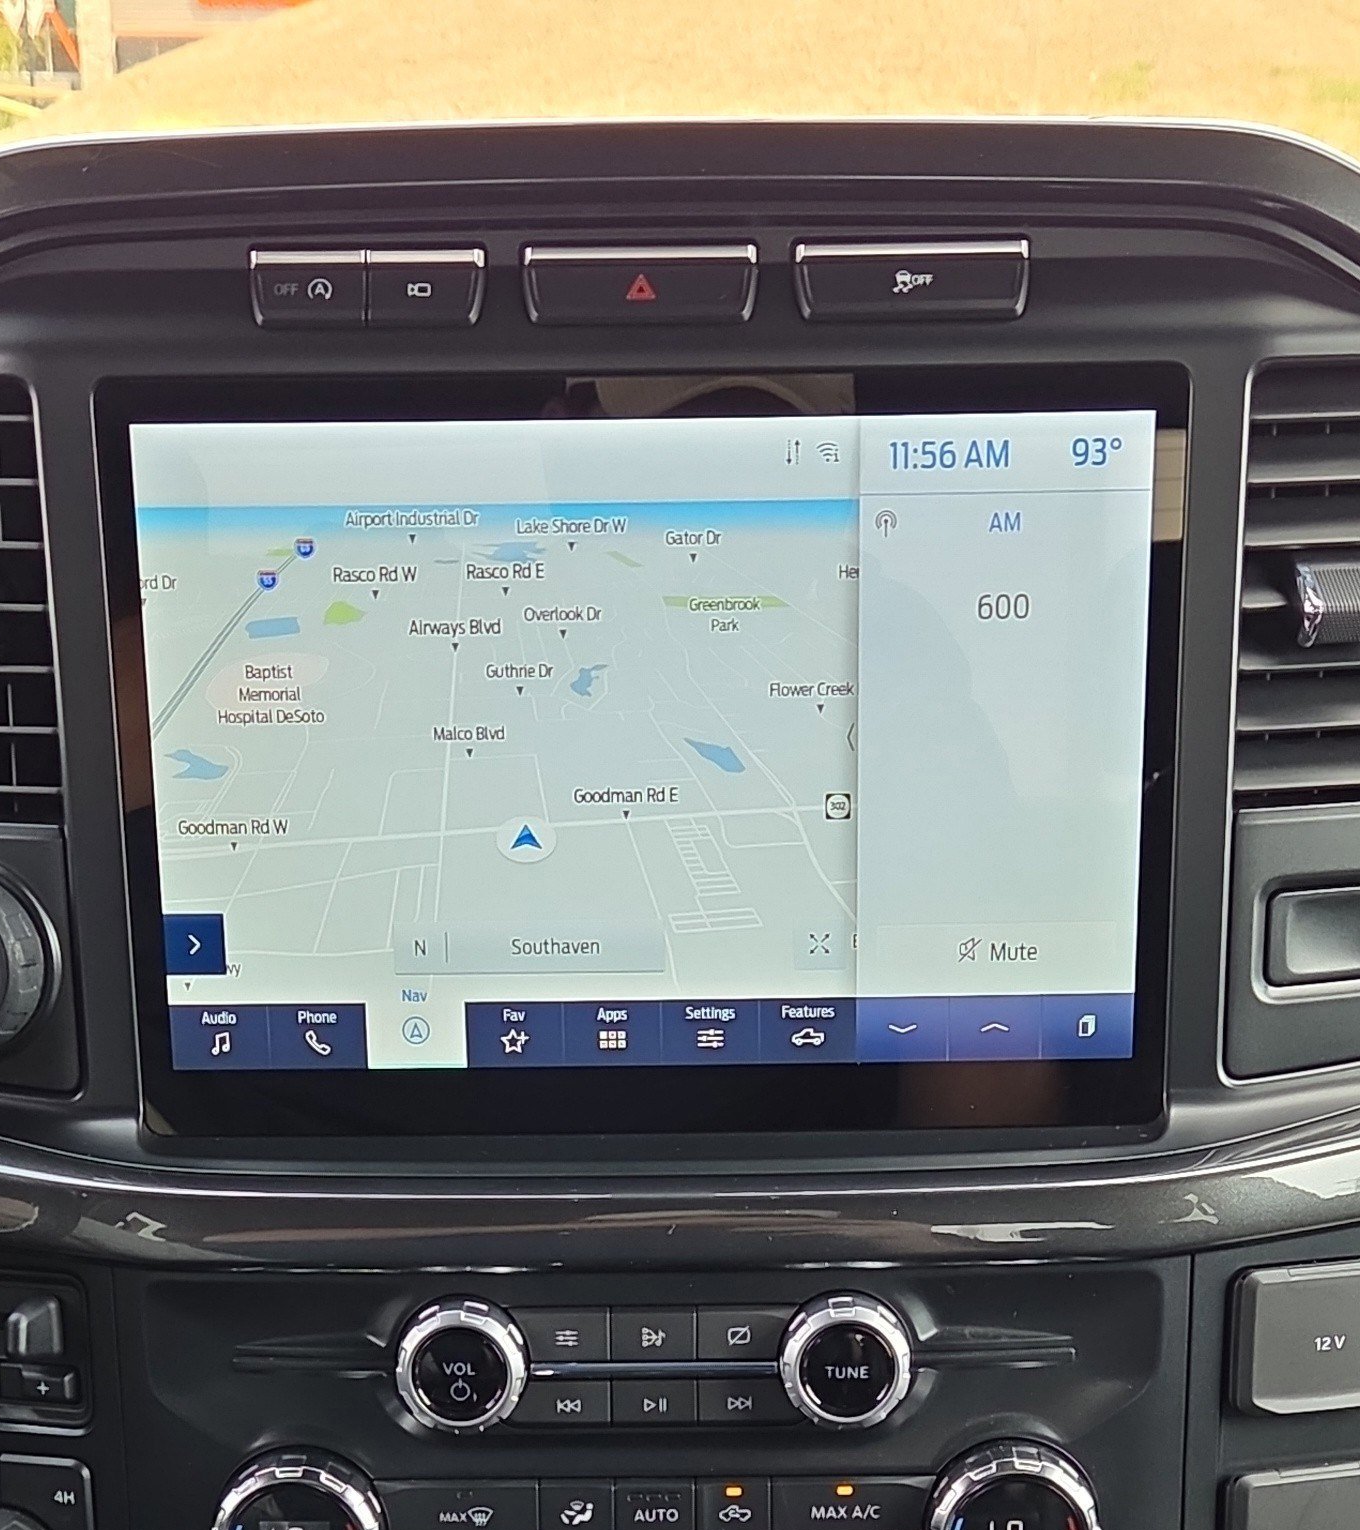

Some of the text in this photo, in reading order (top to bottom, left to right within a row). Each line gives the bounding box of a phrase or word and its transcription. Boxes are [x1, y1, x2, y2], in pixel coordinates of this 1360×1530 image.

[911, 274, 933, 286] OFF
[274, 284, 299, 296] OFF
[889, 439, 1010, 470] 11:56 AM
[1071, 437, 1122, 466] 93°
[345, 511, 479, 529] Airport Industrial Dr
[517, 518, 627, 534] Lake Shore Dr W
[989, 511, 1021, 532] AM
[665, 531, 722, 545] Gator Dr
[333, 566, 417, 582] Rasco Rd W
[467, 564, 545, 580] Rasco Rd E
[162, 575, 177, 589] Dr
[689, 598, 760, 612] Greenbrook
[977, 593, 1030, 620] 600
[524, 607, 602, 622] Overlook Dr
[409, 619, 502, 638] Airways Blvd
[711, 619, 739, 632] Park
[245, 665, 293, 682] Baptist
[486, 664, 554, 678] Guthrie Dr
[239, 687, 301, 702] Memorial
[769, 682, 854, 697] Flower Creek
[218, 710, 325, 726] Hospital DeSoto
[433, 727, 505, 741] Malco Blvd
[573, 787, 679, 804] Goodman Rd E
[178, 819, 288, 836] Goodman Rd W
[414, 940, 427, 956] N
[511, 938, 600, 955] Southaven
[990, 943, 1038, 962] Mute
[401, 989, 428, 1002] Nav
[202, 1011, 237, 1025] Audio
[298, 1011, 337, 1024] Phone
[503, 1008, 525, 1022] Fav
[597, 1008, 628, 1023] Apps
[685, 1006, 736, 1021] Settings
[782, 1006, 835, 1019] Features
[1314, 1337, 1332, 1351] 12
[442, 1362, 476, 1377] VOL
[825, 1366, 869, 1380] TUNE
[54, 1491, 75, 1505] 4H
[439, 1512, 467, 1523] MAX
[634, 1509, 679, 1523] AUTO
[811, 1504, 881, 1520] MAX A/C
